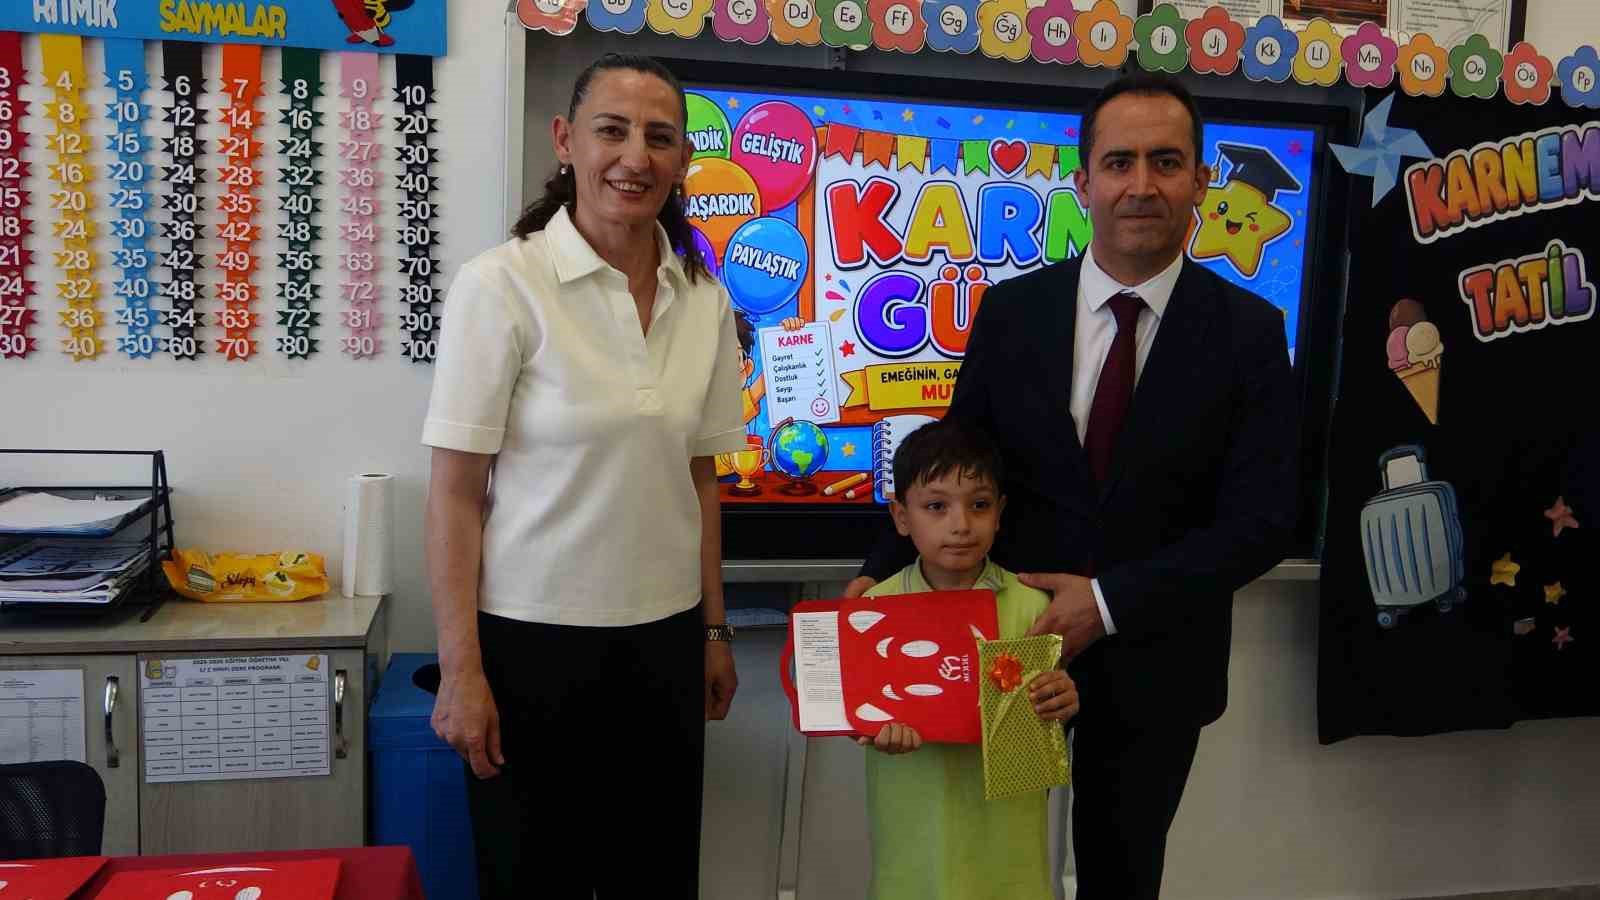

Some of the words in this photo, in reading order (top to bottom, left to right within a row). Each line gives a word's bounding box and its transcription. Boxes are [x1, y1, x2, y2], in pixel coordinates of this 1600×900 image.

[160, 0, 287, 39] SAYMALAR
[789, 5, 808, 20] Dd
[840, 6, 856, 24] Ee
[892, 10, 907, 26] Ff
[942, 12, 962, 33] Gg
[996, 15, 1018, 40] Ğğ
[1048, 23, 1066, 38] Hh
[1210, 31, 1220, 53] Jj
[1261, 39, 1276, 57] Kk
[1358, 51, 1381, 64] Mm
[1414, 60, 1432, 72] Nn
[1466, 61, 1484, 75] Oo
[1517, 64, 1536, 81] Öö
[56, 71, 72, 91] 4
[118, 70, 134, 90] 5
[175, 75, 190, 96] 6
[233, 78, 248, 99] 7
[293, 78, 308, 100] 8
[352, 79, 368, 98] 9
[1578, 74, 1591, 89] Pp
[402, 85, 426, 106] 10
[0, 100, 12, 121] 6
[60, 103, 75, 123] 8
[114, 102, 138, 122] 10
[170, 106, 195, 126] 12
[228, 108, 252, 130] 14
[288, 108, 312, 130] 16
[346, 110, 370, 130] 18
[402, 114, 429, 134] 20
[0, 129, 12, 150] 9
[56, 134, 82, 154] 12
[114, 132, 140, 154] 15
[170, 136, 194, 157] 18
[226, 136, 249, 158] 21
[286, 136, 312, 159] 24
[688, 125, 724, 152] NDİK
[741, 132, 804, 164] GELİŞTİK
[346, 140, 372, 161] 27
[402, 144, 429, 164] 30
[57, 163, 84, 184] 16
[112, 160, 144, 181] 20
[170, 164, 196, 184] 24
[226, 166, 252, 186] 28
[287, 165, 314, 186] 32
[347, 167, 374, 187] 36
[400, 172, 429, 194] 40
[1406, 125, 1600, 239] KARNEM
[56, 190, 86, 210] 20
[114, 189, 144, 210] 25
[170, 192, 197, 213] 30
[224, 193, 252, 214] 35
[284, 194, 312, 214] 40
[344, 198, 372, 216] 45
[685, 193, 756, 222] AŞARDIK
[403, 200, 430, 220] 50
[0, 216, 20, 237] 18
[62, 220, 87, 240] 24
[118, 218, 145, 238] 30
[167, 220, 195, 240] 36
[222, 222, 250, 242] 42
[282, 222, 310, 242] 48
[348, 222, 374, 242] 54
[826, 177, 1094, 269] KARN
[402, 226, 430, 246] 60
[0, 245, 20, 266] 21
[62, 250, 90, 270] 28
[119, 248, 147, 269] 35
[165, 250, 194, 270] 42
[220, 251, 250, 271] 49
[285, 250, 312, 270] 56
[346, 252, 373, 271] 63
[731, 243, 801, 280] PAYLAŞTIK
[404, 256, 430, 276] 70
[0, 276, 24, 296] 24
[63, 279, 91, 300] 32
[119, 278, 148, 298] 40
[166, 280, 195, 300] 48
[221, 282, 250, 302] 56
[285, 281, 312, 301] 64
[347, 281, 373, 300] 72
[406, 284, 432, 304] 80
[1461, 243, 1592, 336] TATİL
[0, 305, 26, 326] 27
[63, 308, 94, 328] 36
[120, 308, 149, 327] 45
[168, 308, 196, 328] 54
[222, 309, 250, 328] 63
[285, 308, 310, 328] 72
[350, 310, 370, 328] 81
[854, 263, 994, 359] GÜ
[406, 312, 432, 332] 90
[0, 334, 26, 354] 30
[64, 336, 95, 356] 40
[124, 334, 152, 354] 50
[169, 336, 196, 356] 60
[221, 338, 250, 357] 70
[282, 335, 309, 355] 80
[348, 336, 374, 354] 90
[406, 340, 438, 358] 100
[778, 334, 814, 347] KARNE
[772, 354, 793, 362] Gayret
[774, 374, 798, 382] Dostluk
[881, 366, 940, 383] EMEĞİNİN,
[944, 368, 960, 380] GA
[922, 384, 954, 400] MU
